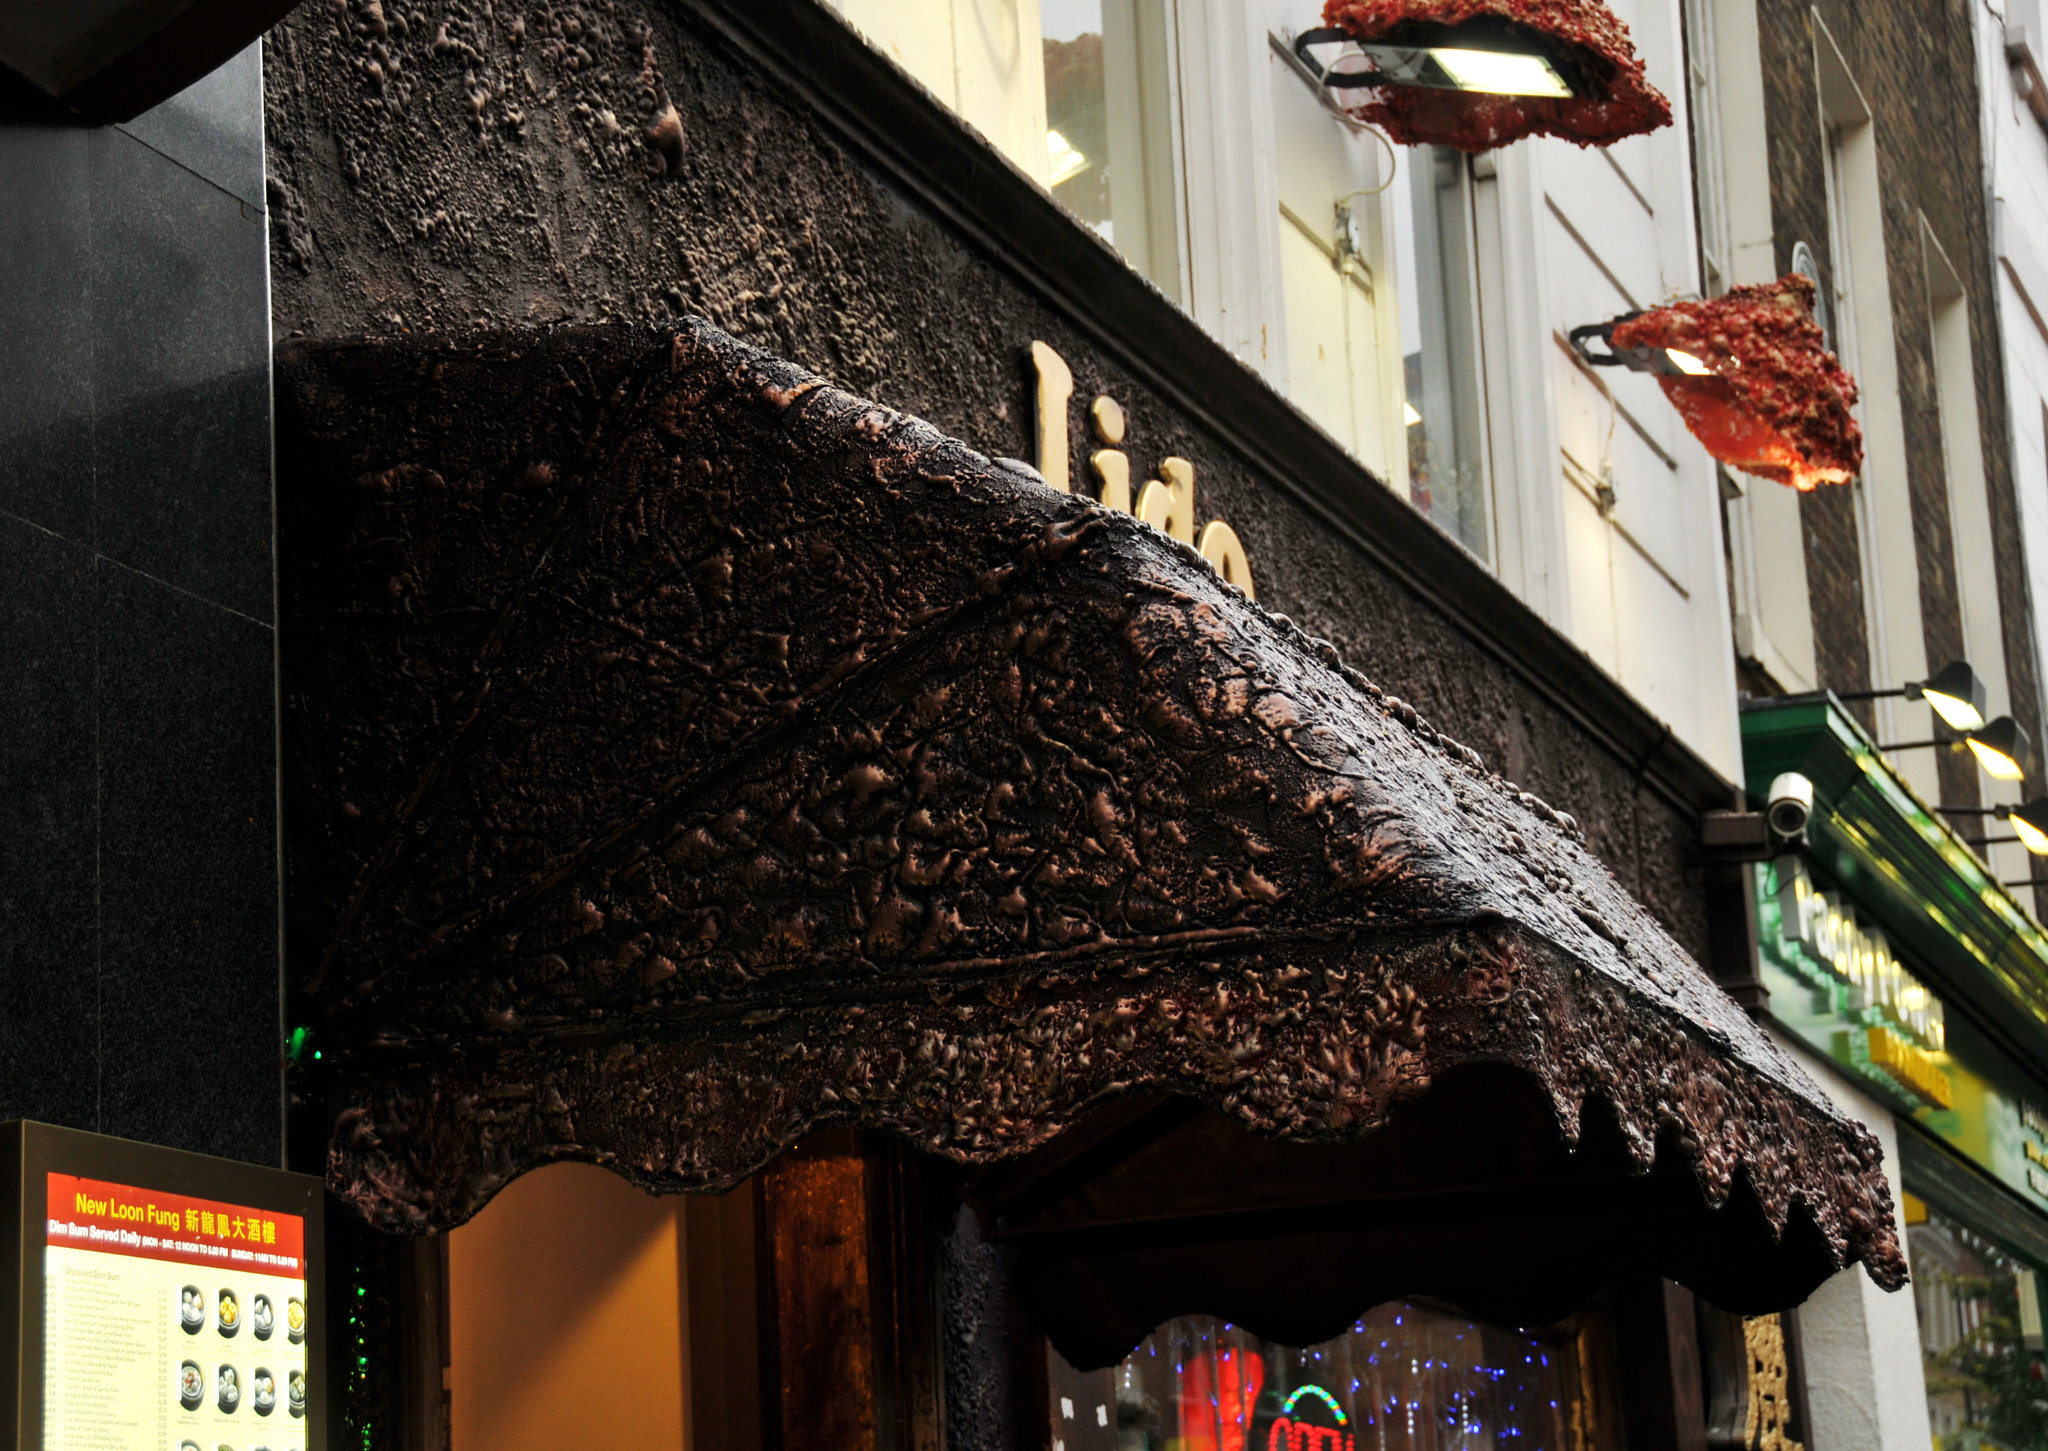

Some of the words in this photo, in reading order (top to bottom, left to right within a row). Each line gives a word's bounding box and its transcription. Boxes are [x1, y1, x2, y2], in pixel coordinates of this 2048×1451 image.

[76, 1193, 107, 1216] New
[111, 1198, 144, 1222] Loon
[148, 1204, 180, 1231] Fung
[49, 1219, 67, 1235] Dim
[68, 1222, 89, 1239] Sum
[89, 1225, 119, 1243] Served
[120, 1229, 141, 1247] Daily
[175, 1240, 182, 1251] 12
[182, 1241, 199, 1253] NOON
[199, 1243, 208, 1255] TO
[220, 1246, 228, 1257] PM
[269, 1252, 277, 1264] TO
